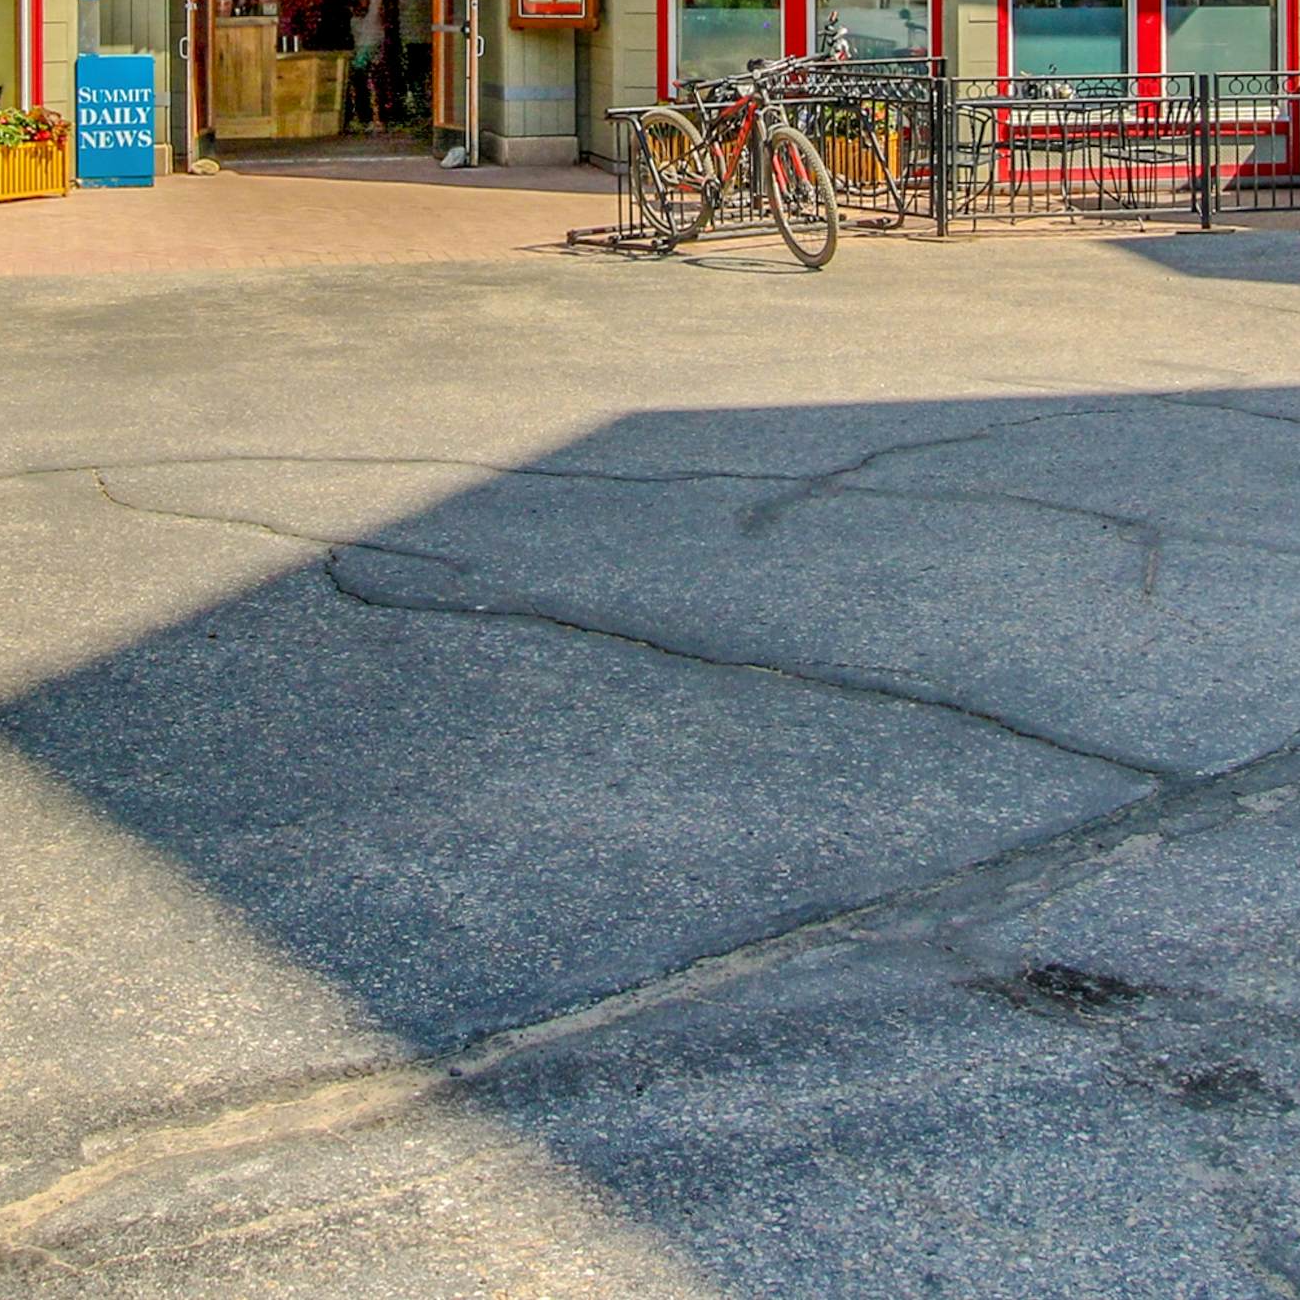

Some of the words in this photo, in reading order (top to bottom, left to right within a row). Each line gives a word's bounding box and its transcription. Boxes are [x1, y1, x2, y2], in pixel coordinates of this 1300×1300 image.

[78, 86, 152, 104] SUMMIT
[80, 106, 152, 126] DAILY
[80, 129, 153, 149] NEWS
